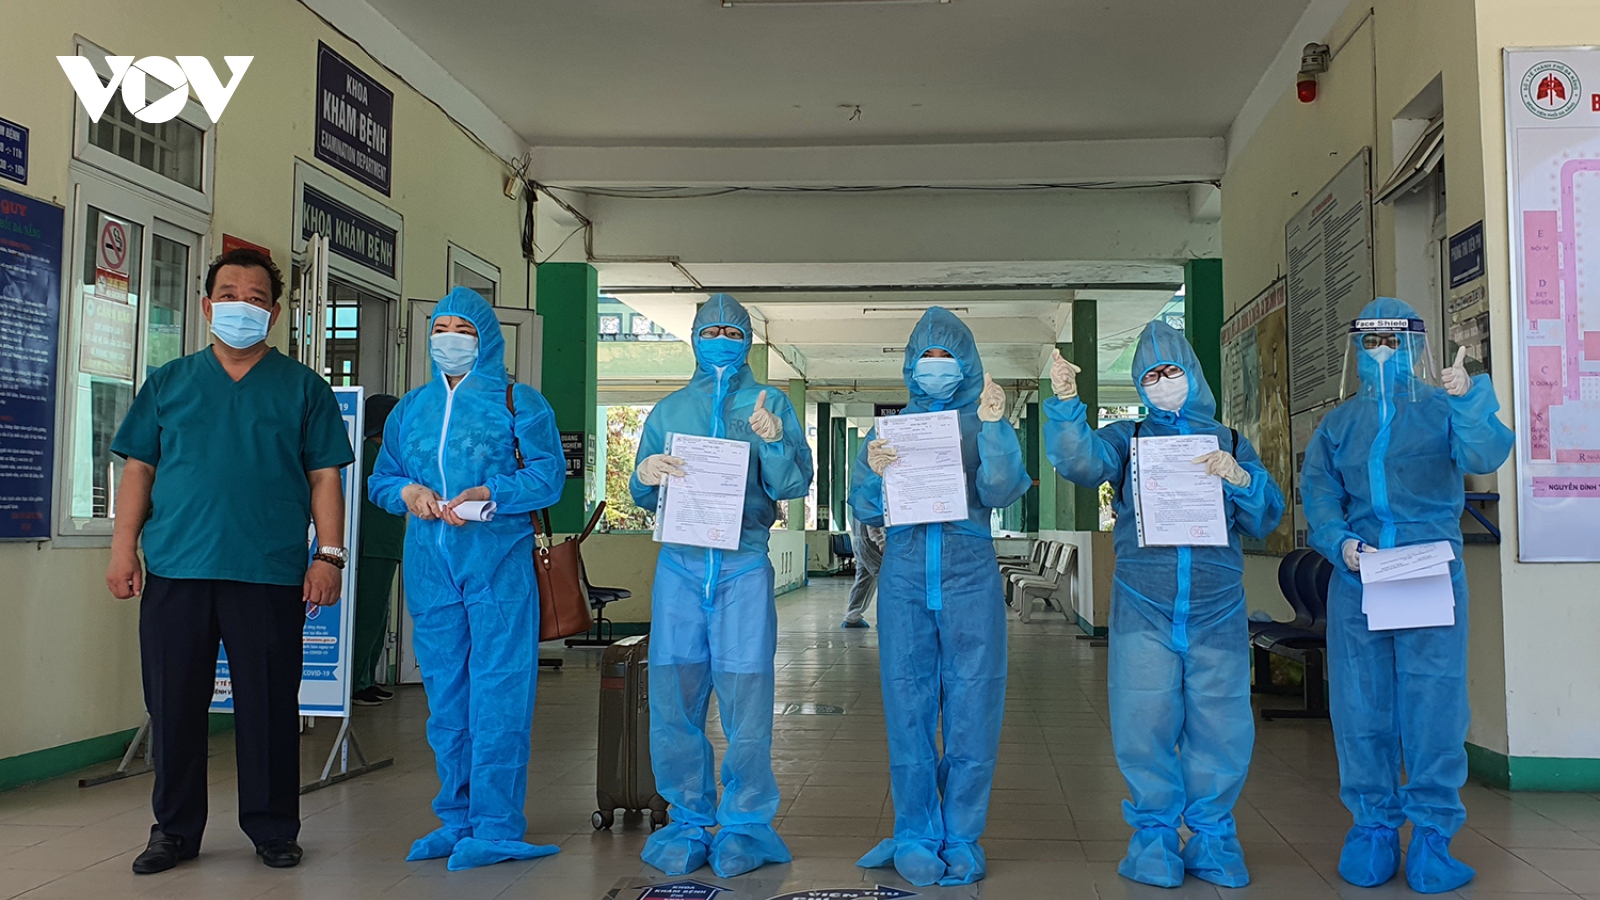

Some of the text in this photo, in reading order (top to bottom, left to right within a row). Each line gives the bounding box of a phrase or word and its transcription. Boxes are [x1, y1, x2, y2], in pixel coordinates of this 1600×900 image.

[346, 74, 368, 106] KHOA
[323, 89, 387, 156] KHÁM BỆNH
[321, 130, 387, 182] EXAMINATION DEPARTMENT
[303, 202, 392, 267] KHOA KHÁM BỆNH
[573, 459, 581, 469] TB
